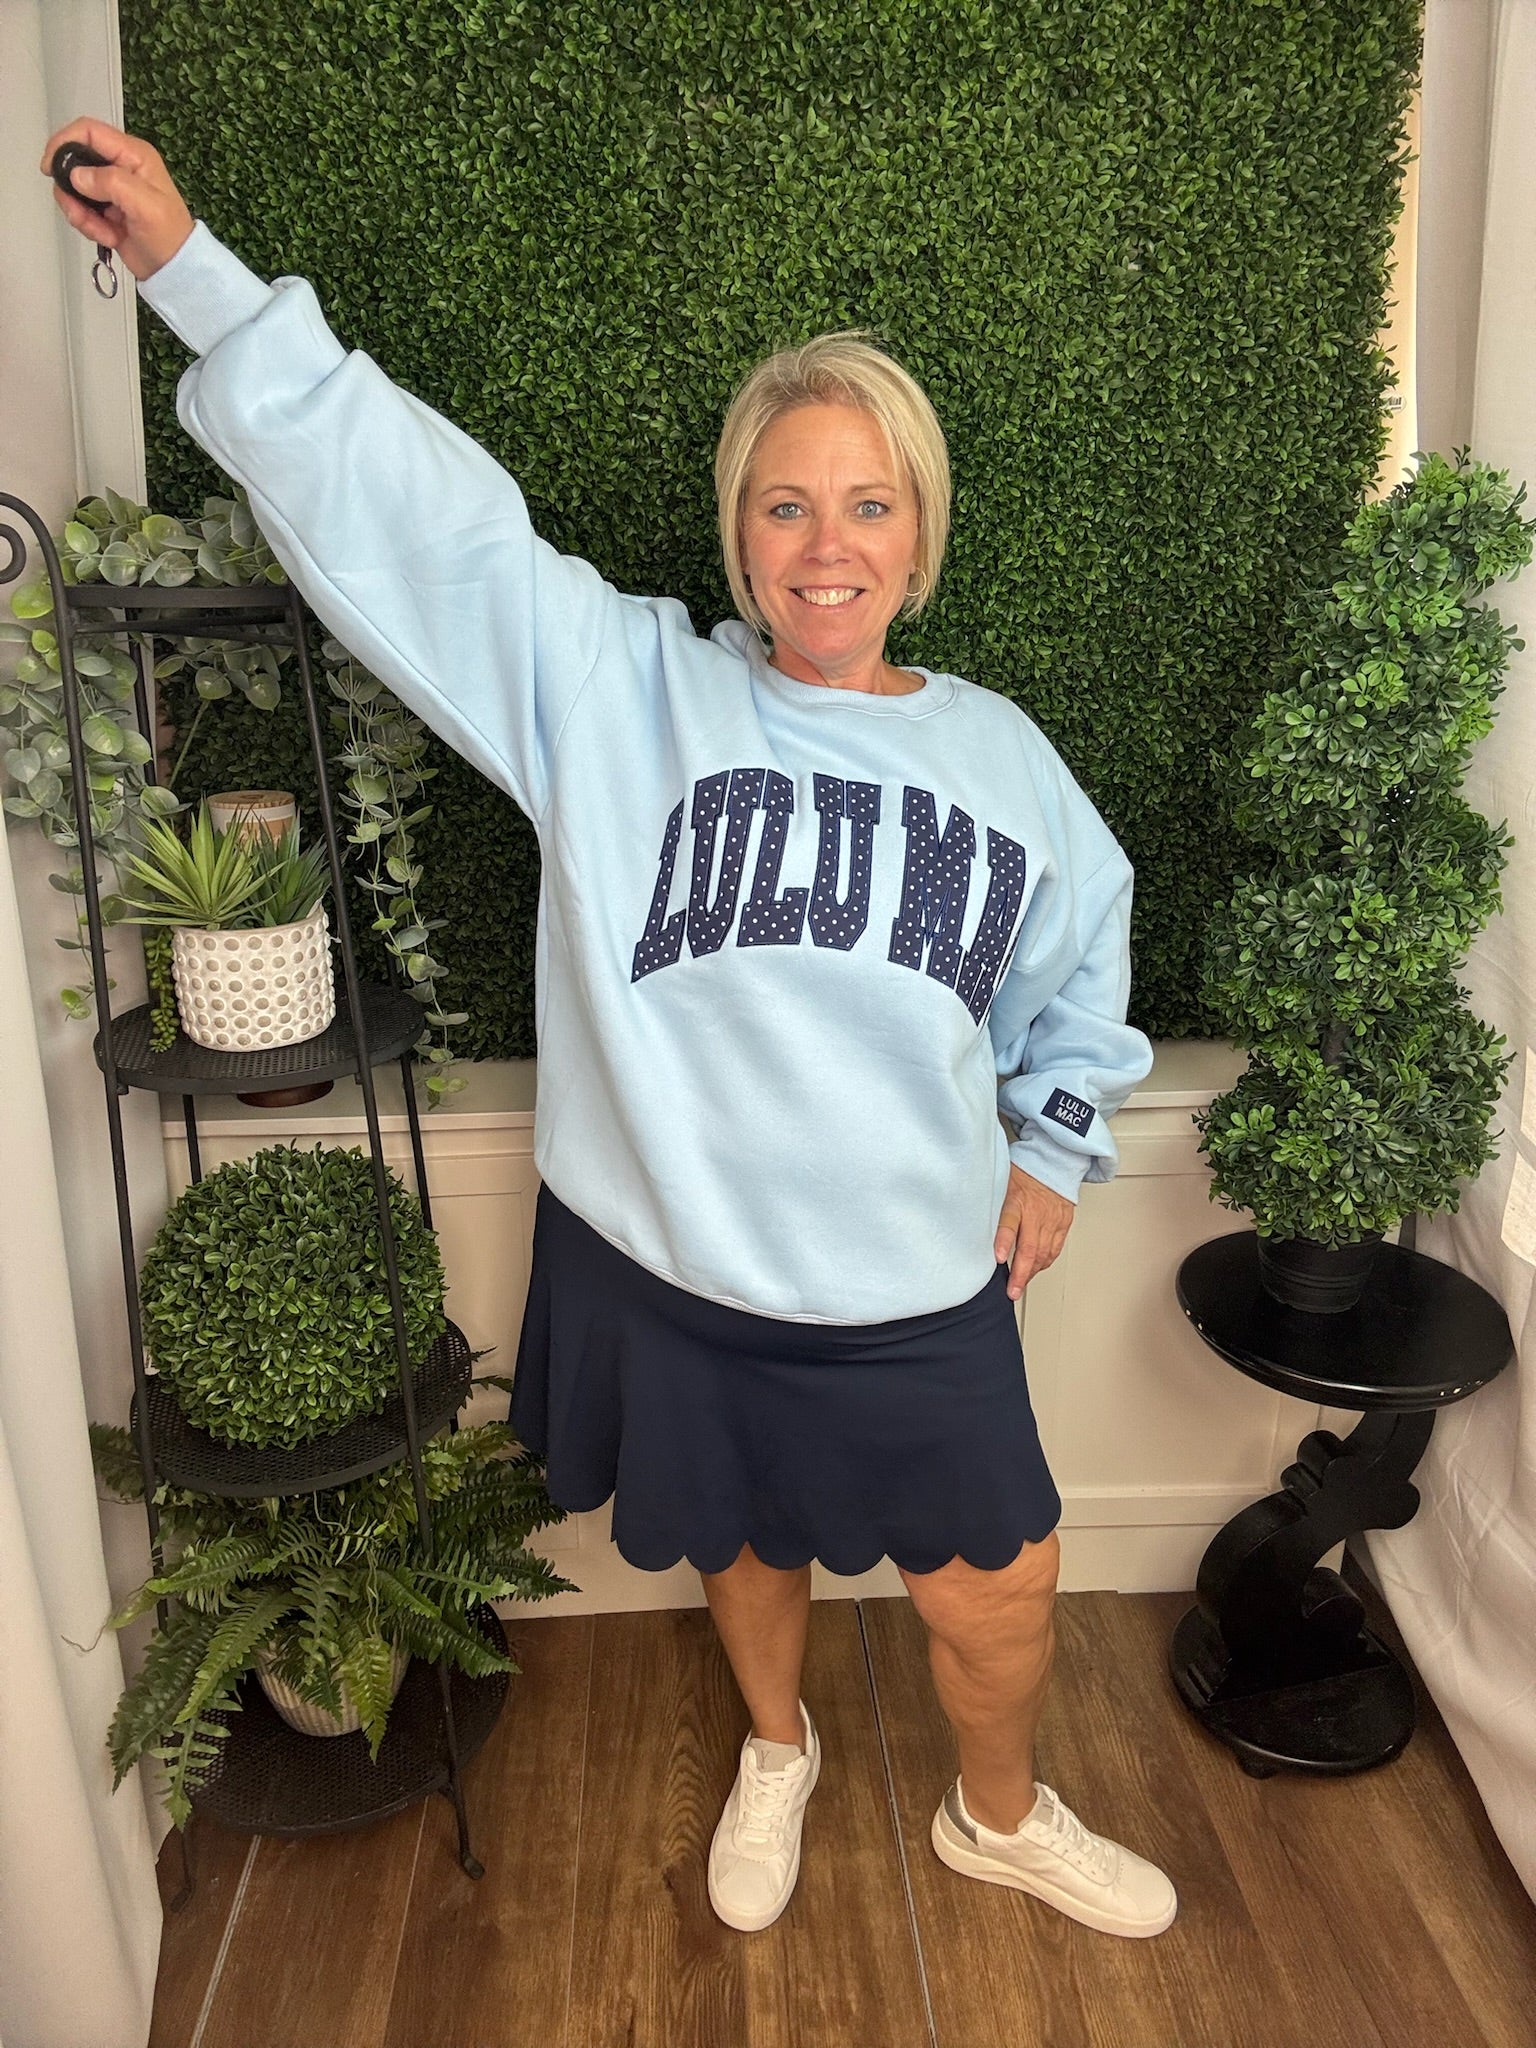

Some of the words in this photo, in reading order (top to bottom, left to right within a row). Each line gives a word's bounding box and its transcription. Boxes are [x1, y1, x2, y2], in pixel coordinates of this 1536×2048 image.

[631, 768, 882, 983] LULU
[887, 785, 1026, 1030] MA
[1055, 1107, 1082, 1128] MAC
[1058, 1095, 1090, 1118] LULU
